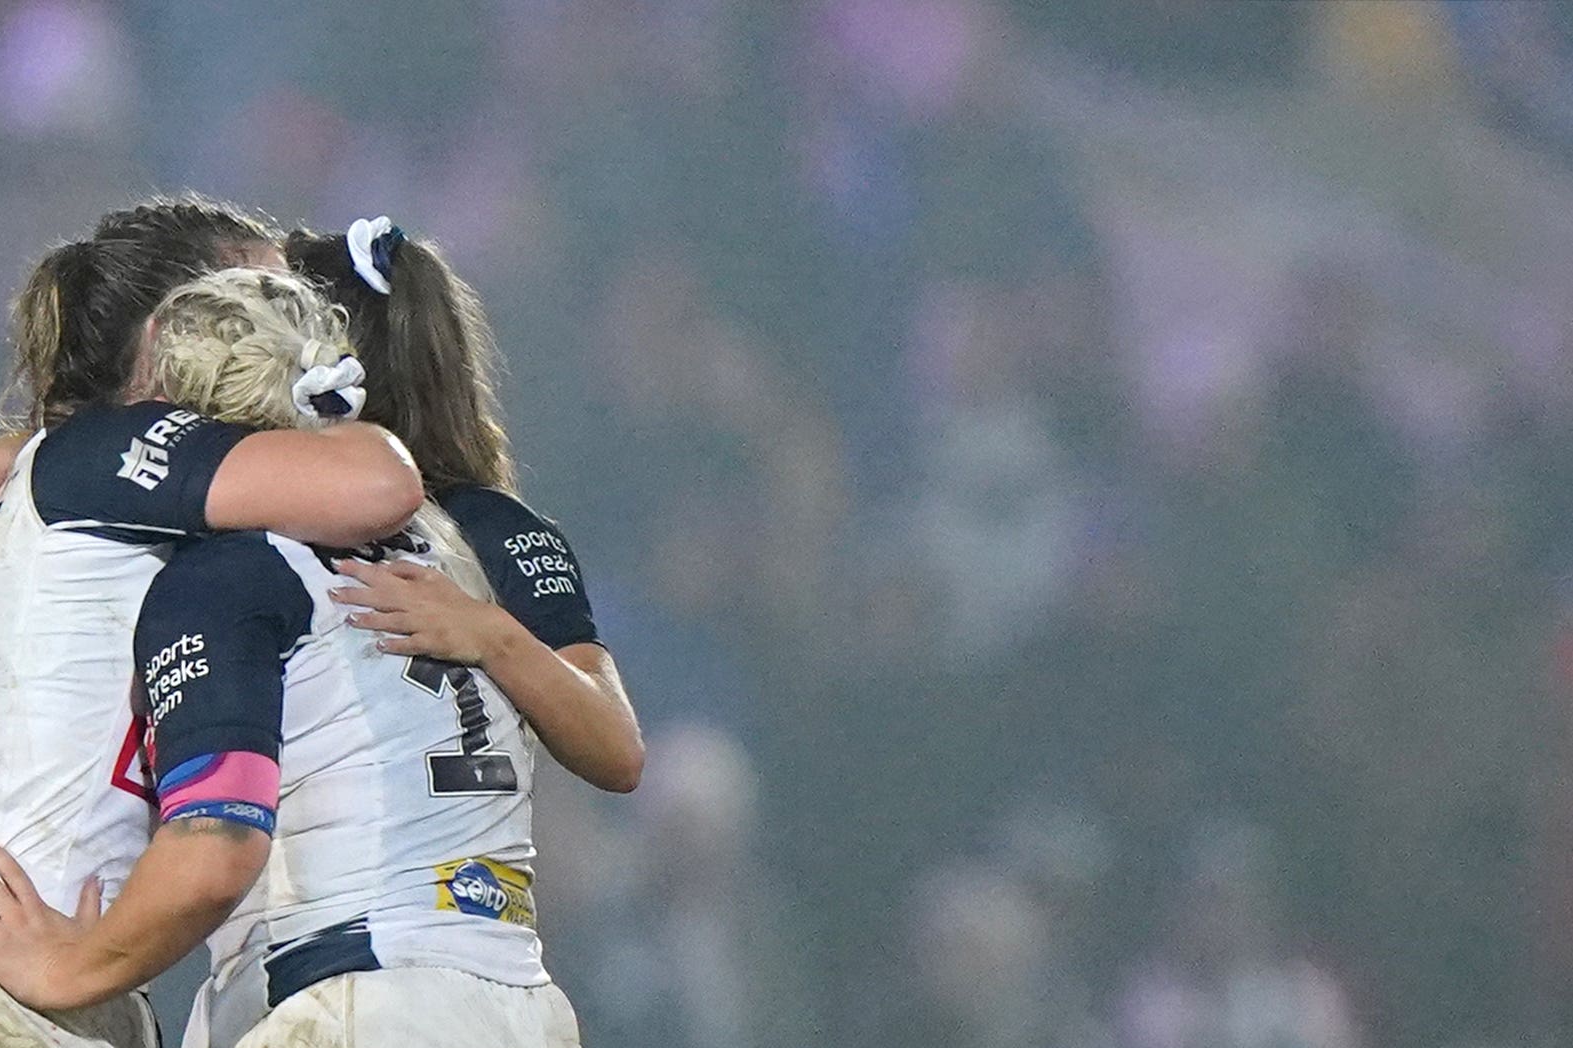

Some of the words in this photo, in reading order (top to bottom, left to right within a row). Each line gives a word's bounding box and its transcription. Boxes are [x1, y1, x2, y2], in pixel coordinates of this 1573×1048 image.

[144, 409, 204, 446] RE
[504, 531, 567, 555] sports
[533, 576, 576, 598] .com
